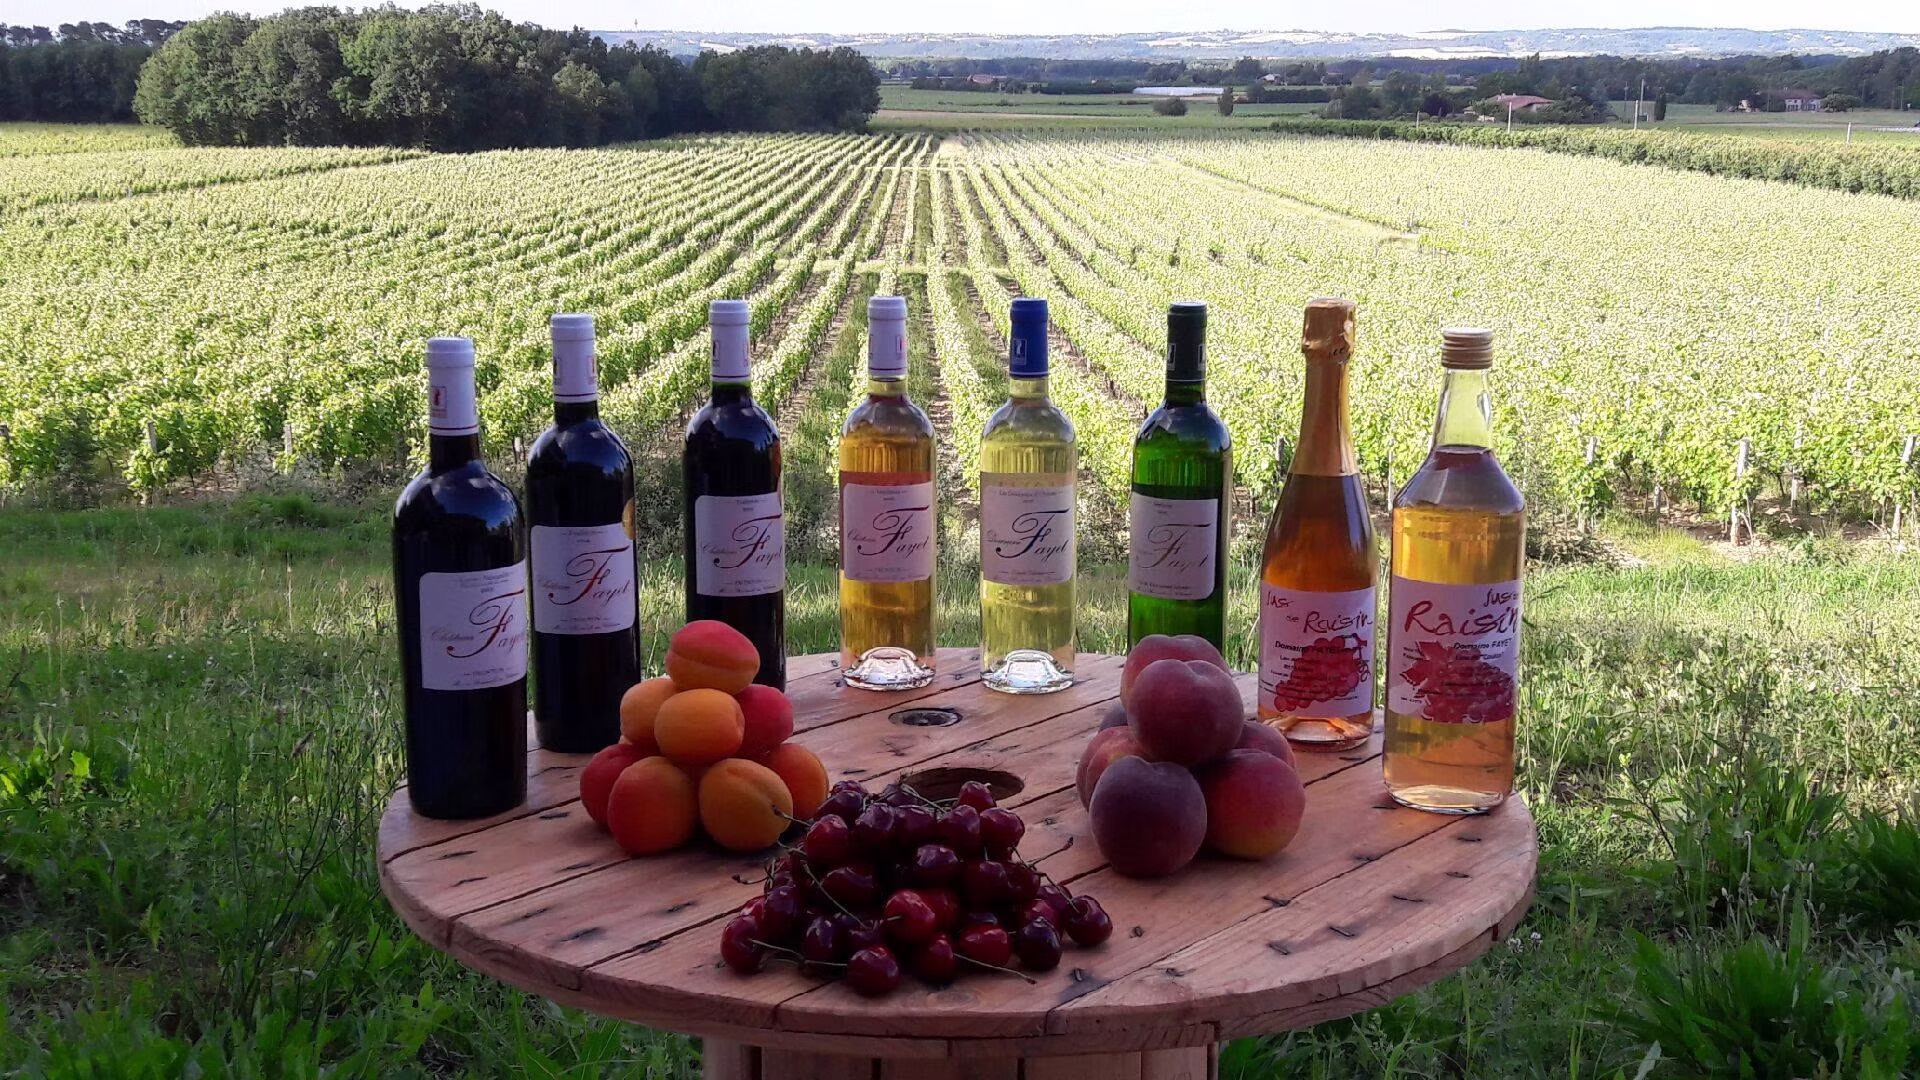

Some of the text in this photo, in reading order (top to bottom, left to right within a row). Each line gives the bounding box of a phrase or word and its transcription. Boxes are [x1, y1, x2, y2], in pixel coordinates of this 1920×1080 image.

[713, 513, 783, 570] Fayet
[857, 505, 930, 559] Fayet
[995, 507, 1071, 562] Fayet
[548, 545, 631, 607] Fayet
[446, 588, 525, 658] Fay
[1303, 611, 1374, 634] Raisin
[1404, 600, 1518, 636] Raisin
